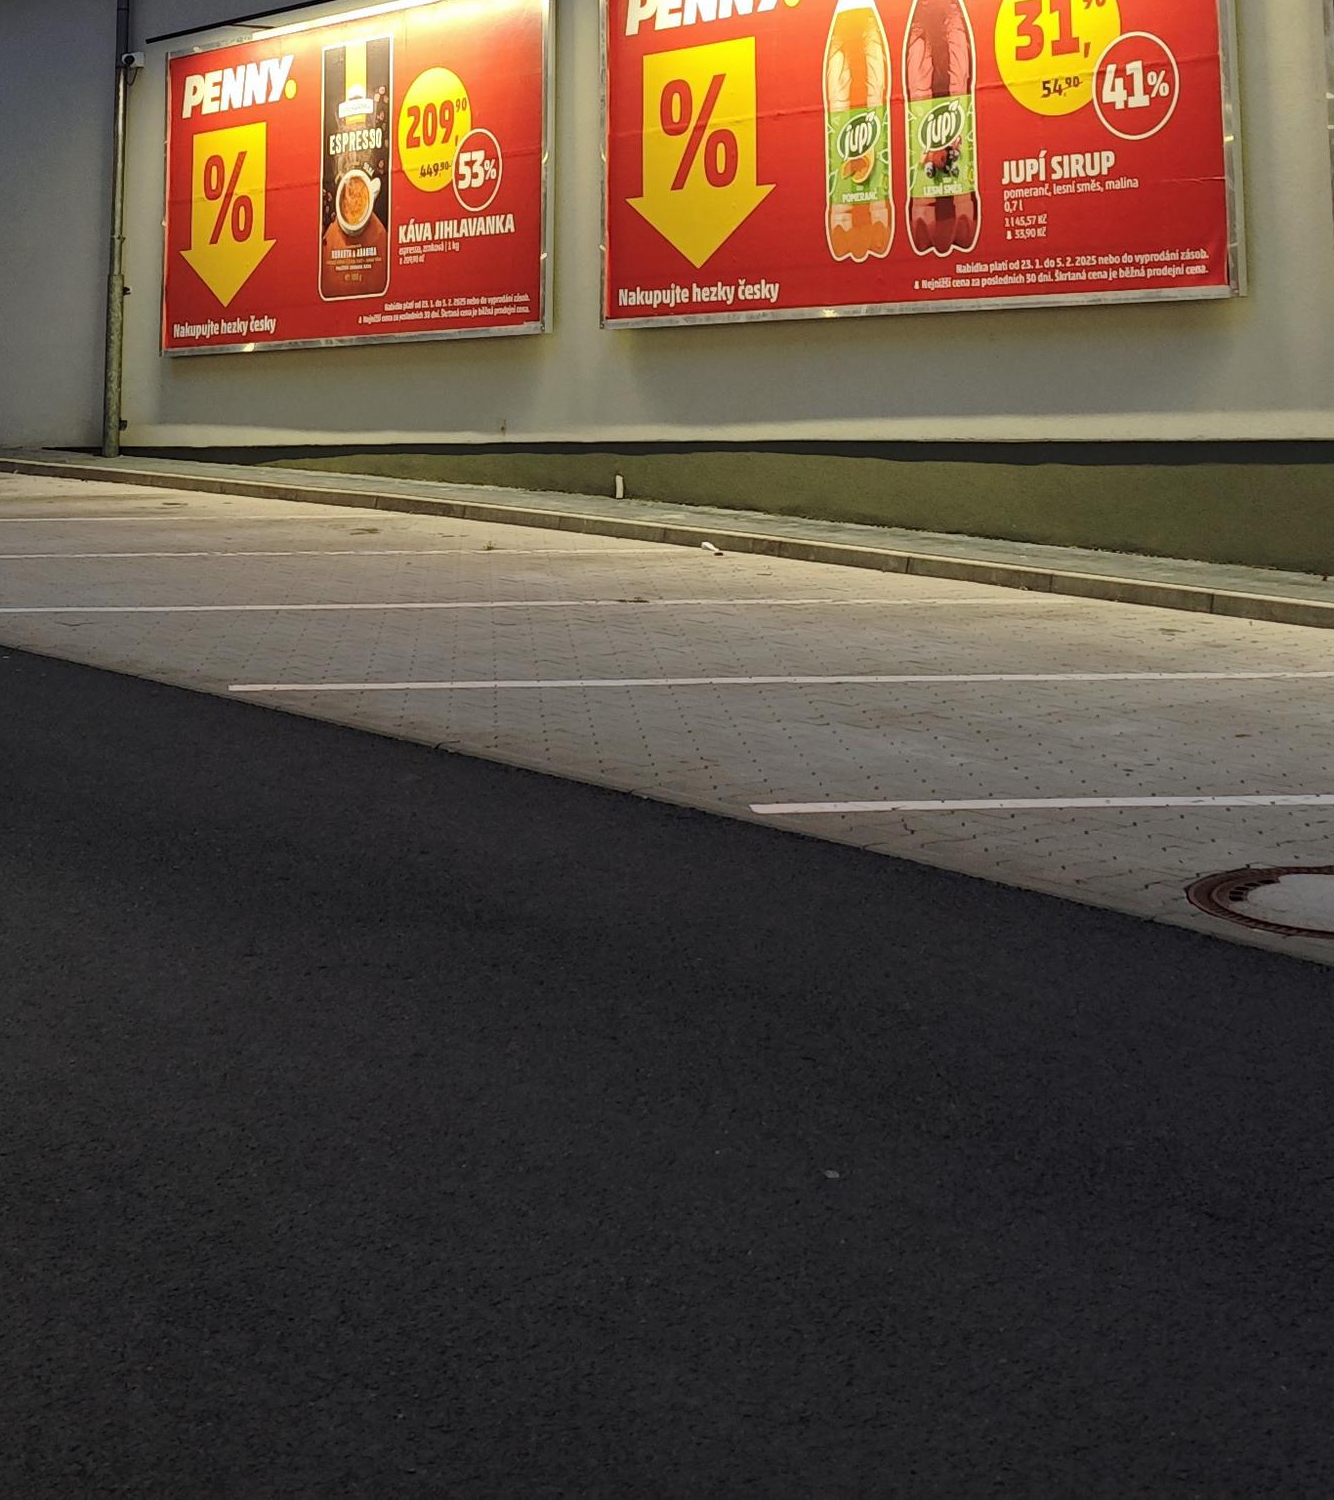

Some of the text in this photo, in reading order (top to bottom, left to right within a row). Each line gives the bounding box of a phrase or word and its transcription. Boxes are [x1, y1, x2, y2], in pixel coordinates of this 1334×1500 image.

[1102, 60, 1170, 110] 41%
[329, 127, 383, 156] ESPRESSO
[660, 73, 738, 191] %
[458, 150, 497, 190] 53%
[1001, 150, 1115, 185] JUPÍ SIRUP
[203, 150, 254, 245] %
[1004, 177, 1139, 201] pomeranč, lesní směs, malina
[1004, 200, 1018, 213] 0,7
[398, 213, 515, 244] KÁVA JIHLAVANKA
[952, 278, 970, 288] cena
[1026, 274, 1036, 284] 30
[1088, 270, 1107, 279] cena
[1108, 267, 1117, 280] je
[1119, 266, 1145, 278] běžná
[1147, 264, 1184, 278] prodejní
[956, 262, 989, 274] Nabídka
[989, 260, 1008, 273] platí
[1009, 260, 1020, 270] od
[1044, 258, 1055, 268] do
[1075, 255, 1097, 266] 2025
[1098, 253, 1120, 265] nebo
[1121, 253, 1132, 263] do
[1134, 249, 1179, 265] vyprodání
[618, 279, 779, 308] Nakupujte hezky česky
[173, 315, 277, 340] Nakupujte hezky česky
